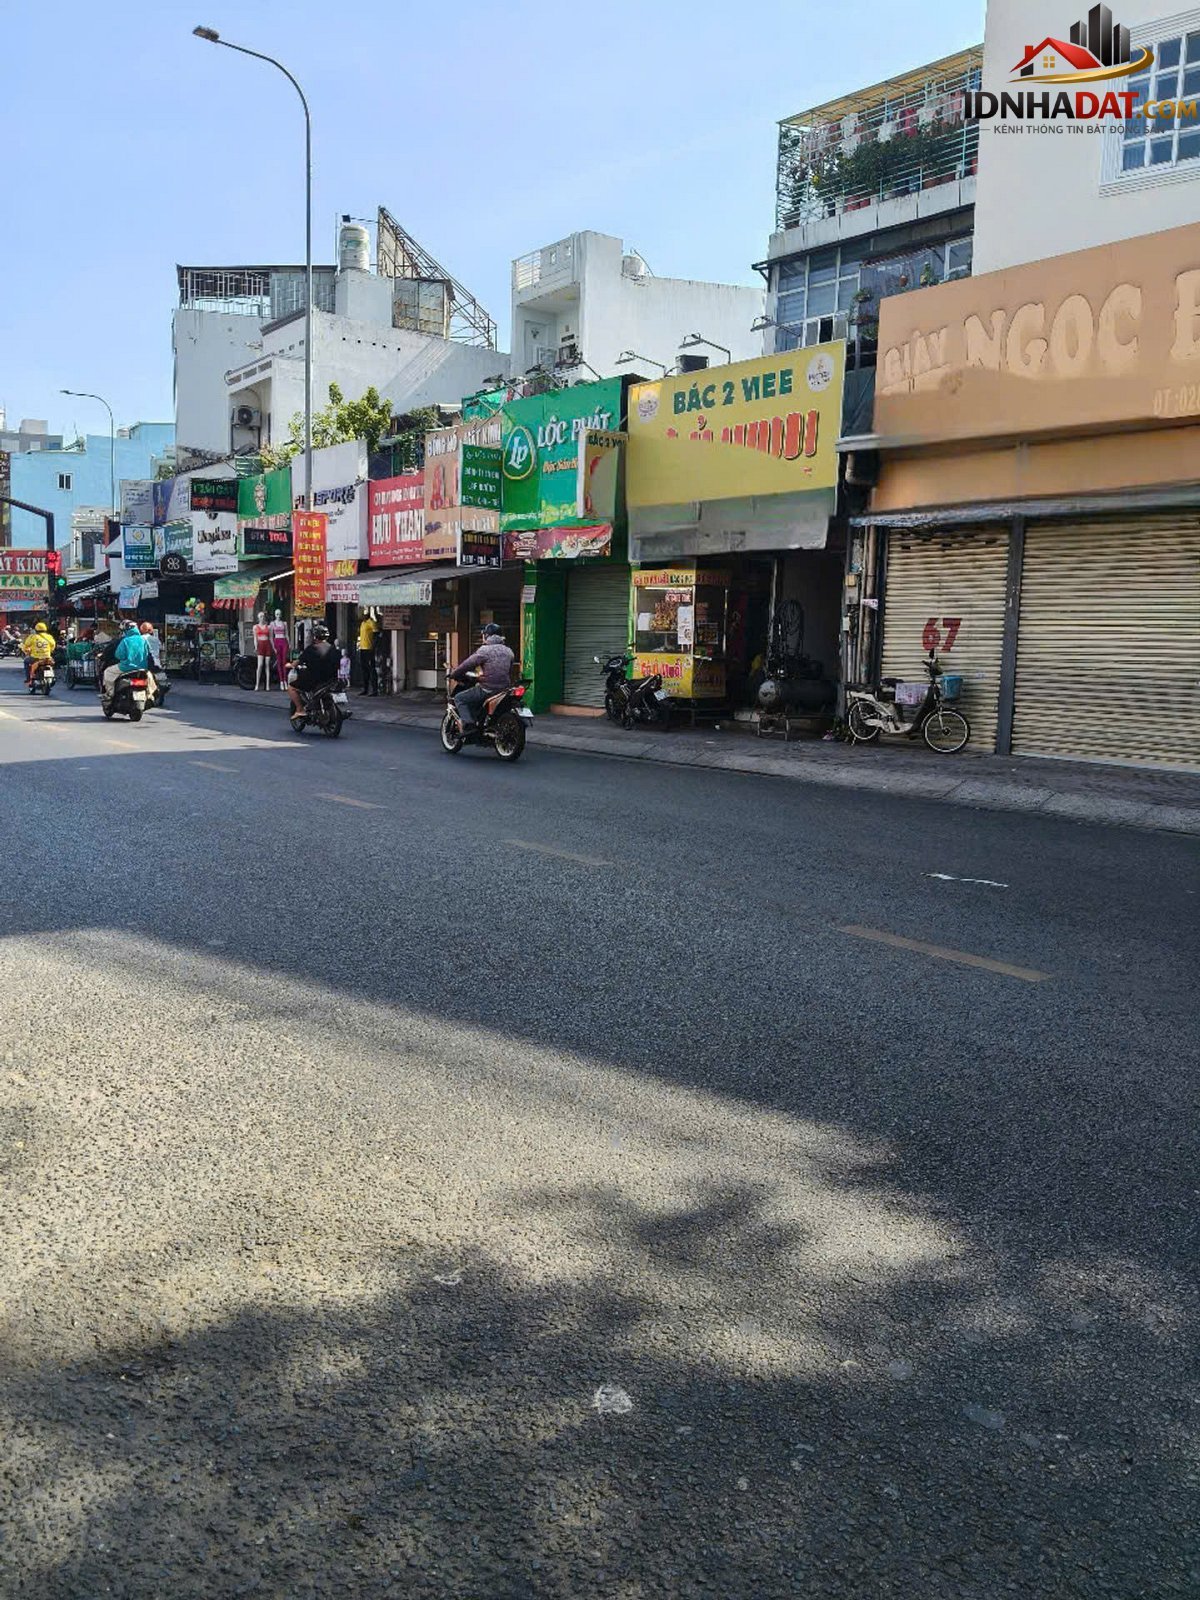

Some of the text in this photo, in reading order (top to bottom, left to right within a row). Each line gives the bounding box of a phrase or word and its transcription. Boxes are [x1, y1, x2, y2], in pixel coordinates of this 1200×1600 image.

[673, 380, 717, 414] BÁC
[722, 380, 735, 405] 2
[537, 415, 568, 450] LỘC
[922, 618, 963, 653] 67
